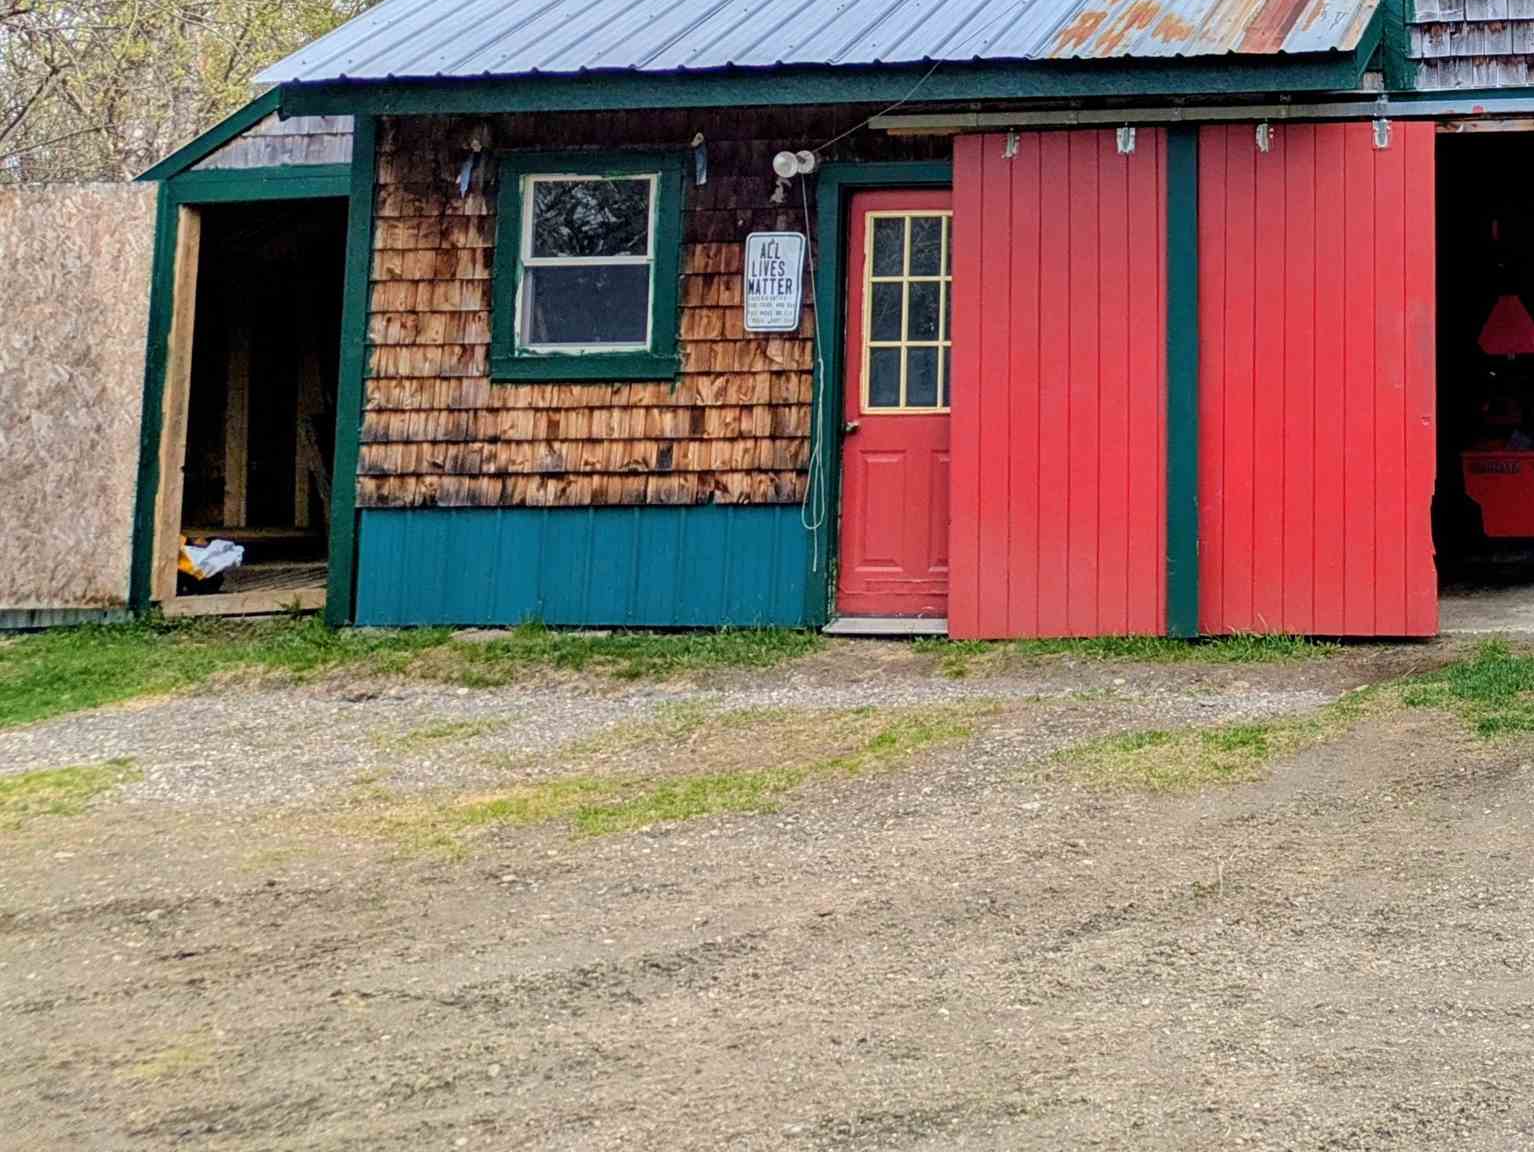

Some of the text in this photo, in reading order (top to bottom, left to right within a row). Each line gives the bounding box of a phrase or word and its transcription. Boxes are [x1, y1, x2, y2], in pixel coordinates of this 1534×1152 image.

[760, 242, 780, 259] ALL
[751, 260, 785, 277] LIVES
[748, 278, 792, 295] MATTER
